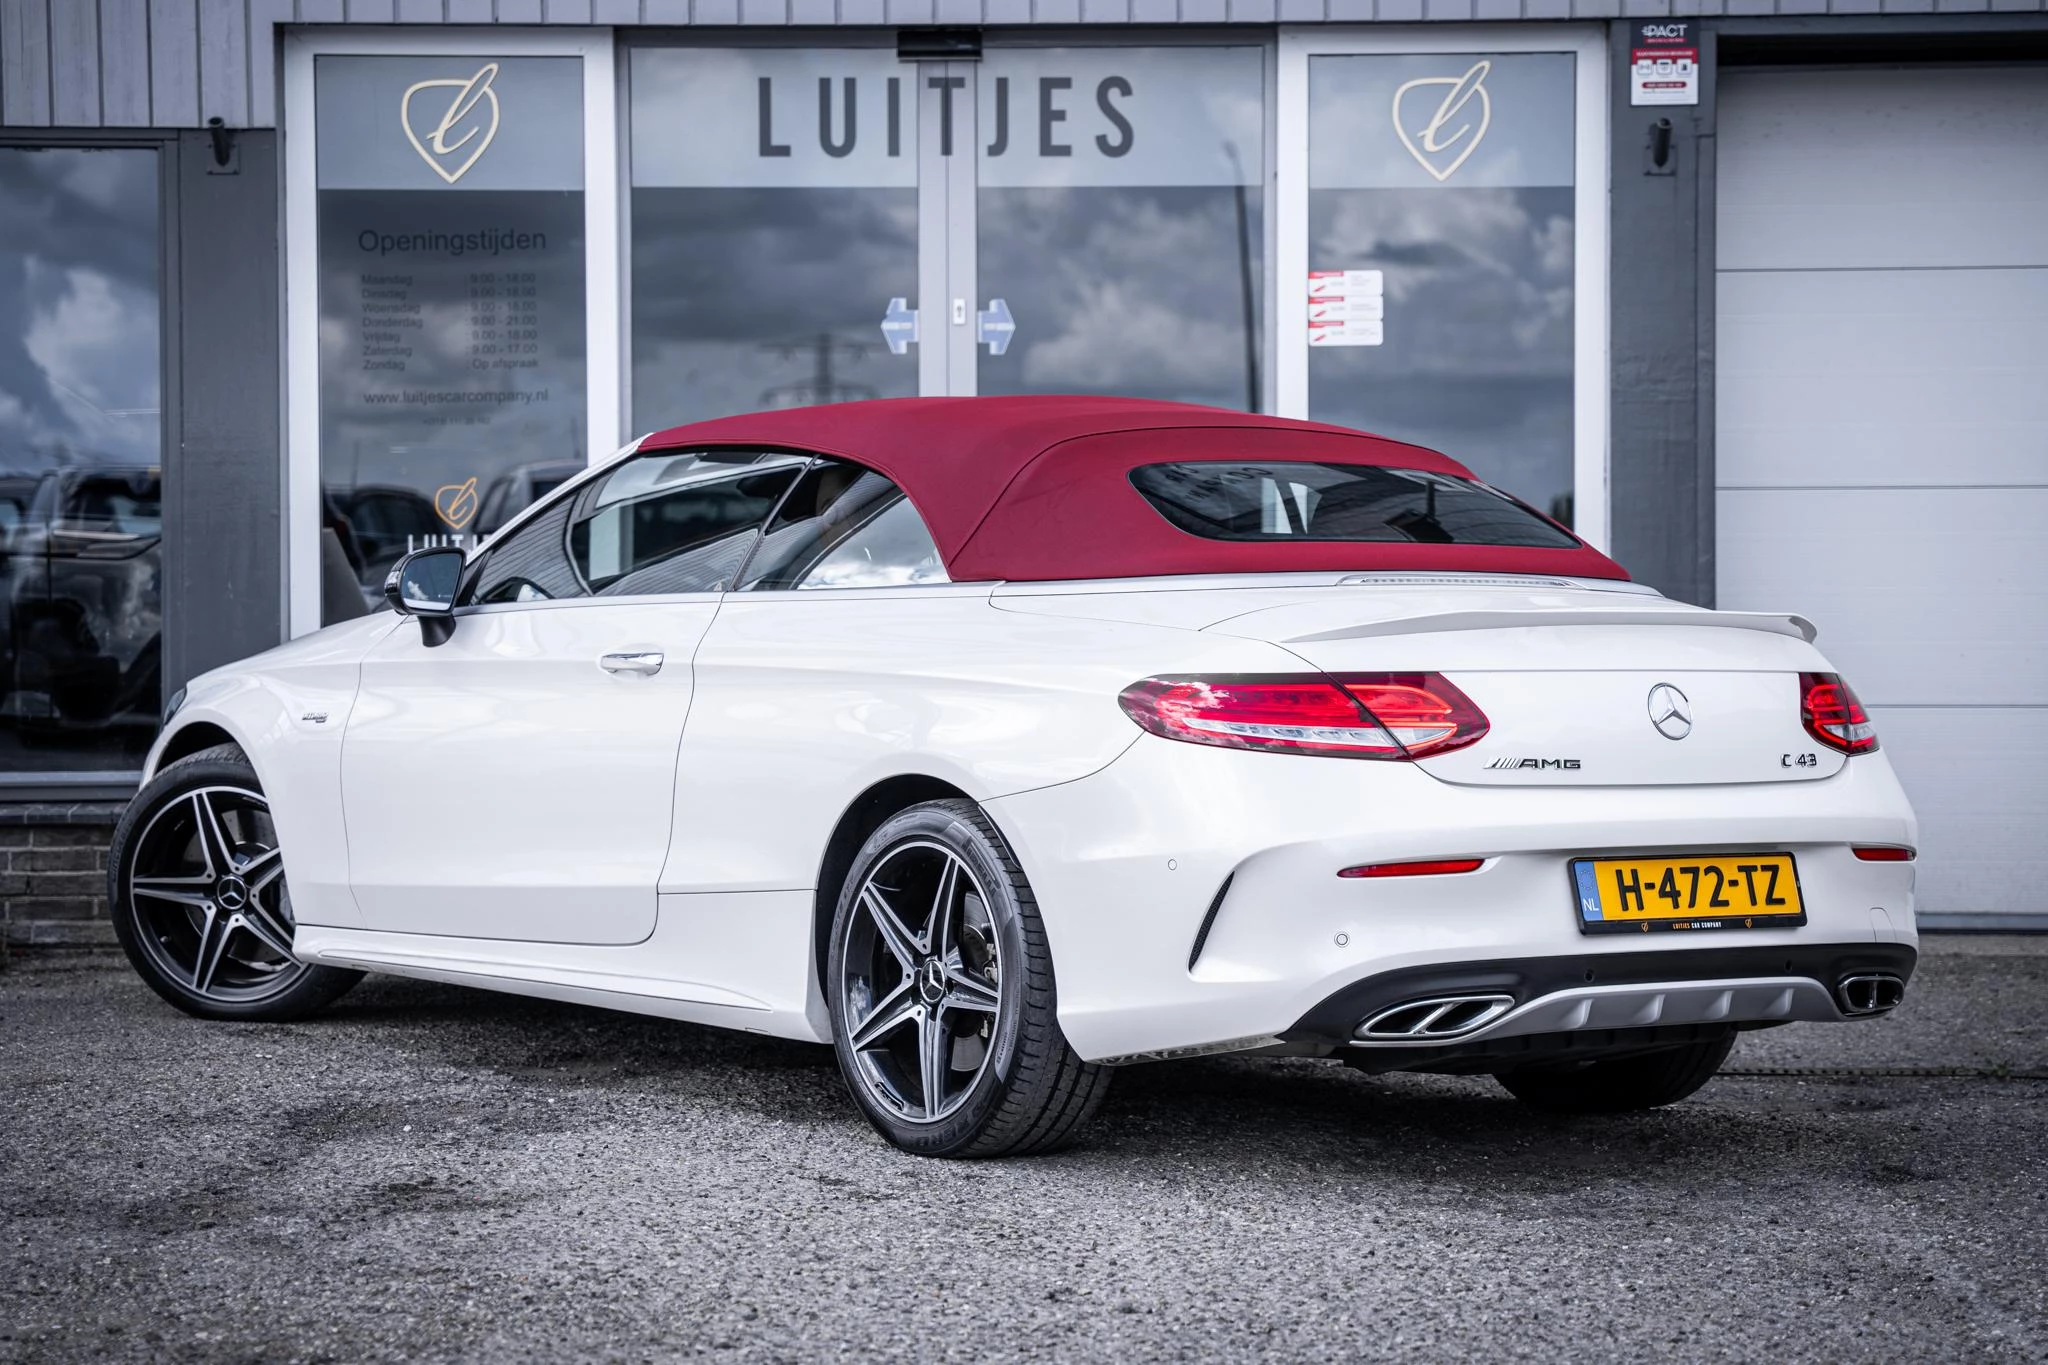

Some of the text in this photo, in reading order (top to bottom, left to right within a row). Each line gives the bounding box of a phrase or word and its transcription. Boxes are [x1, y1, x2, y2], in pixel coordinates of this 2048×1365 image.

[758, 75, 1134, 158] LUITJES
[358, 228, 547, 257] Openingstijden
[361, 274, 413, 286] Maandag
[361, 288, 407, 301] Dinsdag
[362, 302, 420, 315] Woensdag
[362, 317, 423, 329] Donderdag
[363, 331, 400, 344] Vrijdag
[363, 345, 412, 358] Zaterdag
[363, 359, 405, 372] Zondag
[472, 358, 489, 370] Op
[492, 357, 539, 370] afspraak
[363, 388, 548, 406] www.luitjescarcompany.nl
[1519, 759, 1581, 769] AMG
[1781, 753, 1817, 768] C 43
[1615, 865, 1786, 911] H-472-TZ
[1583, 898, 1600, 911] NL
